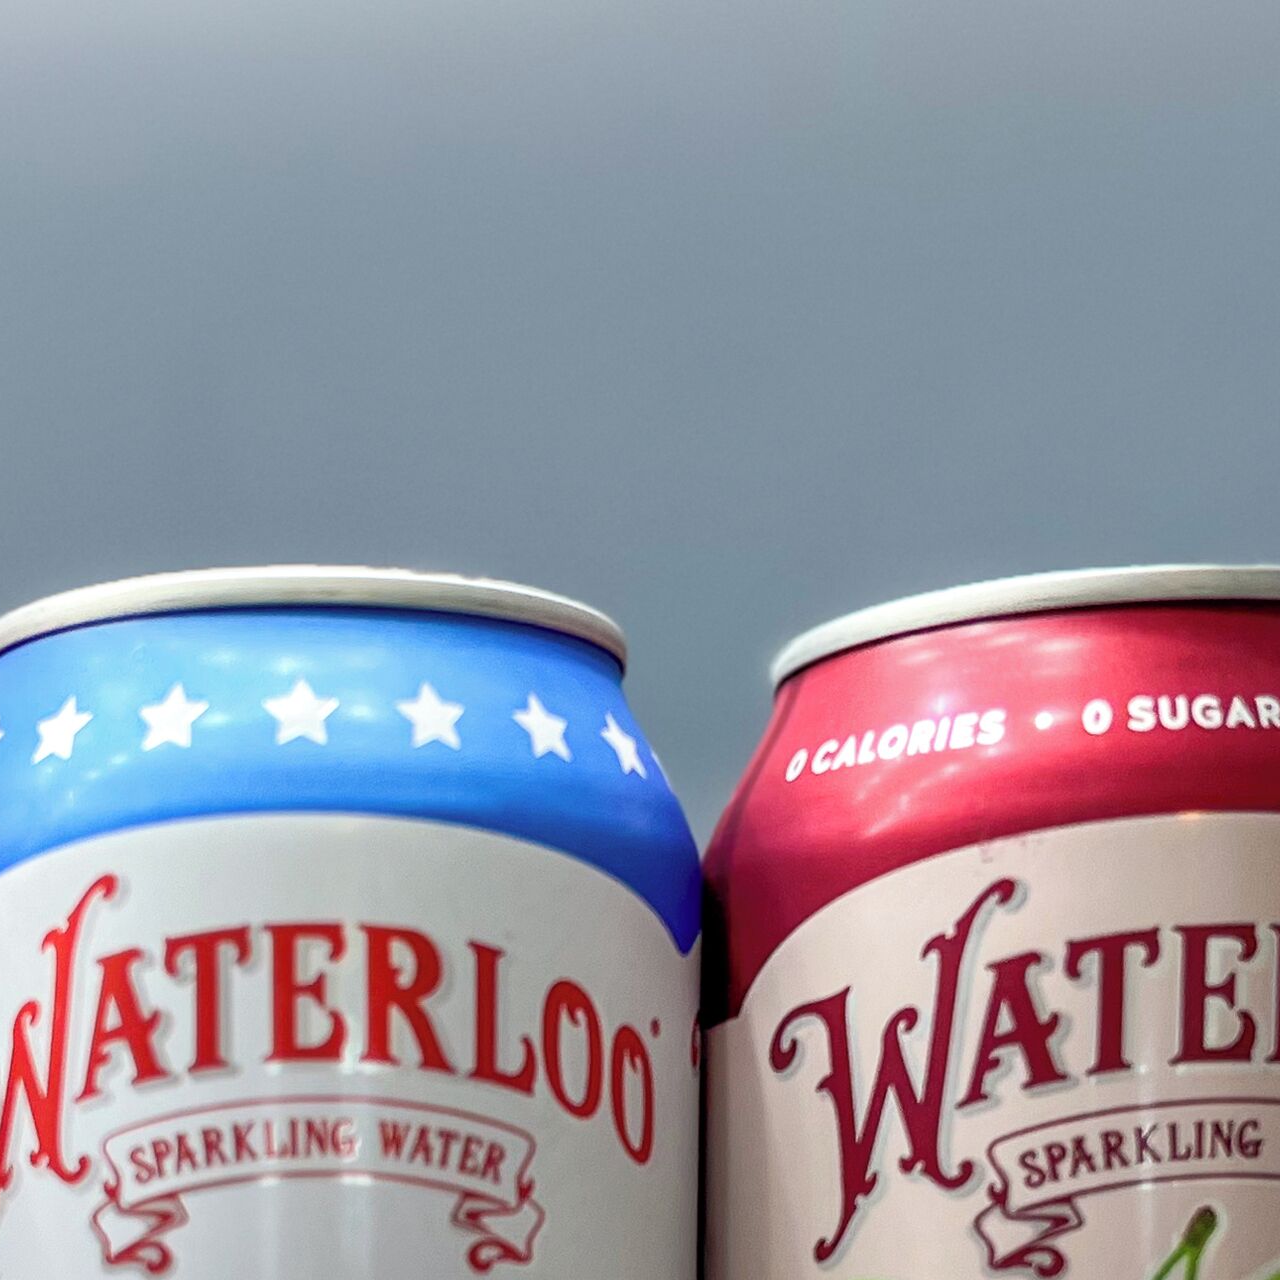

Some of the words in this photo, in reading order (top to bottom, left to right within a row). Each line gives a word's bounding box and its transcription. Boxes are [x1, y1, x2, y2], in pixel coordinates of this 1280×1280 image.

[785, 728, 809, 782] 0
[811, 709, 1006, 775] CALORIES
[1081, 699, 1113, 735] 0
[130, 1118, 360, 1184] SPARKLING
[378, 1118, 508, 1186] WATER
[1019, 1119, 1263, 1188] SPARKLING
